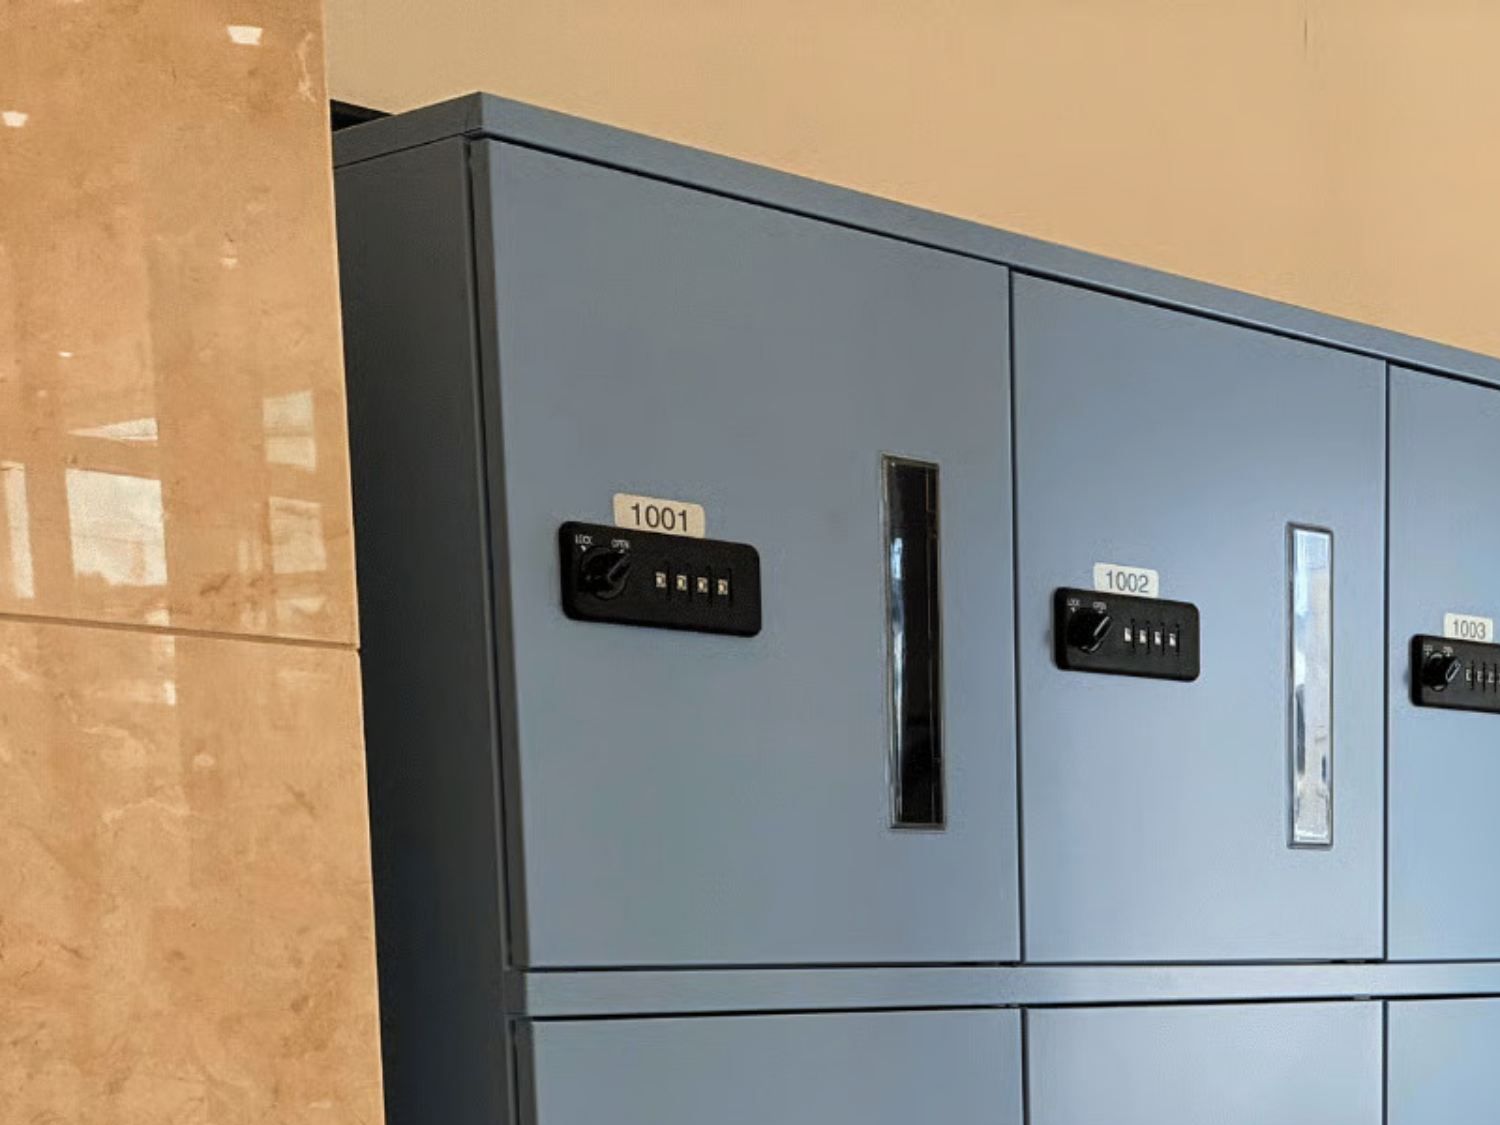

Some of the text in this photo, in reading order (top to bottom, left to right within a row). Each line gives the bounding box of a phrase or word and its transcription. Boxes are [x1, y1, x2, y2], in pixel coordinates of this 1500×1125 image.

[631, 504, 688, 532] 1001
[1106, 570, 1150, 594] 1002
[1454, 620, 1486, 640] 1003
